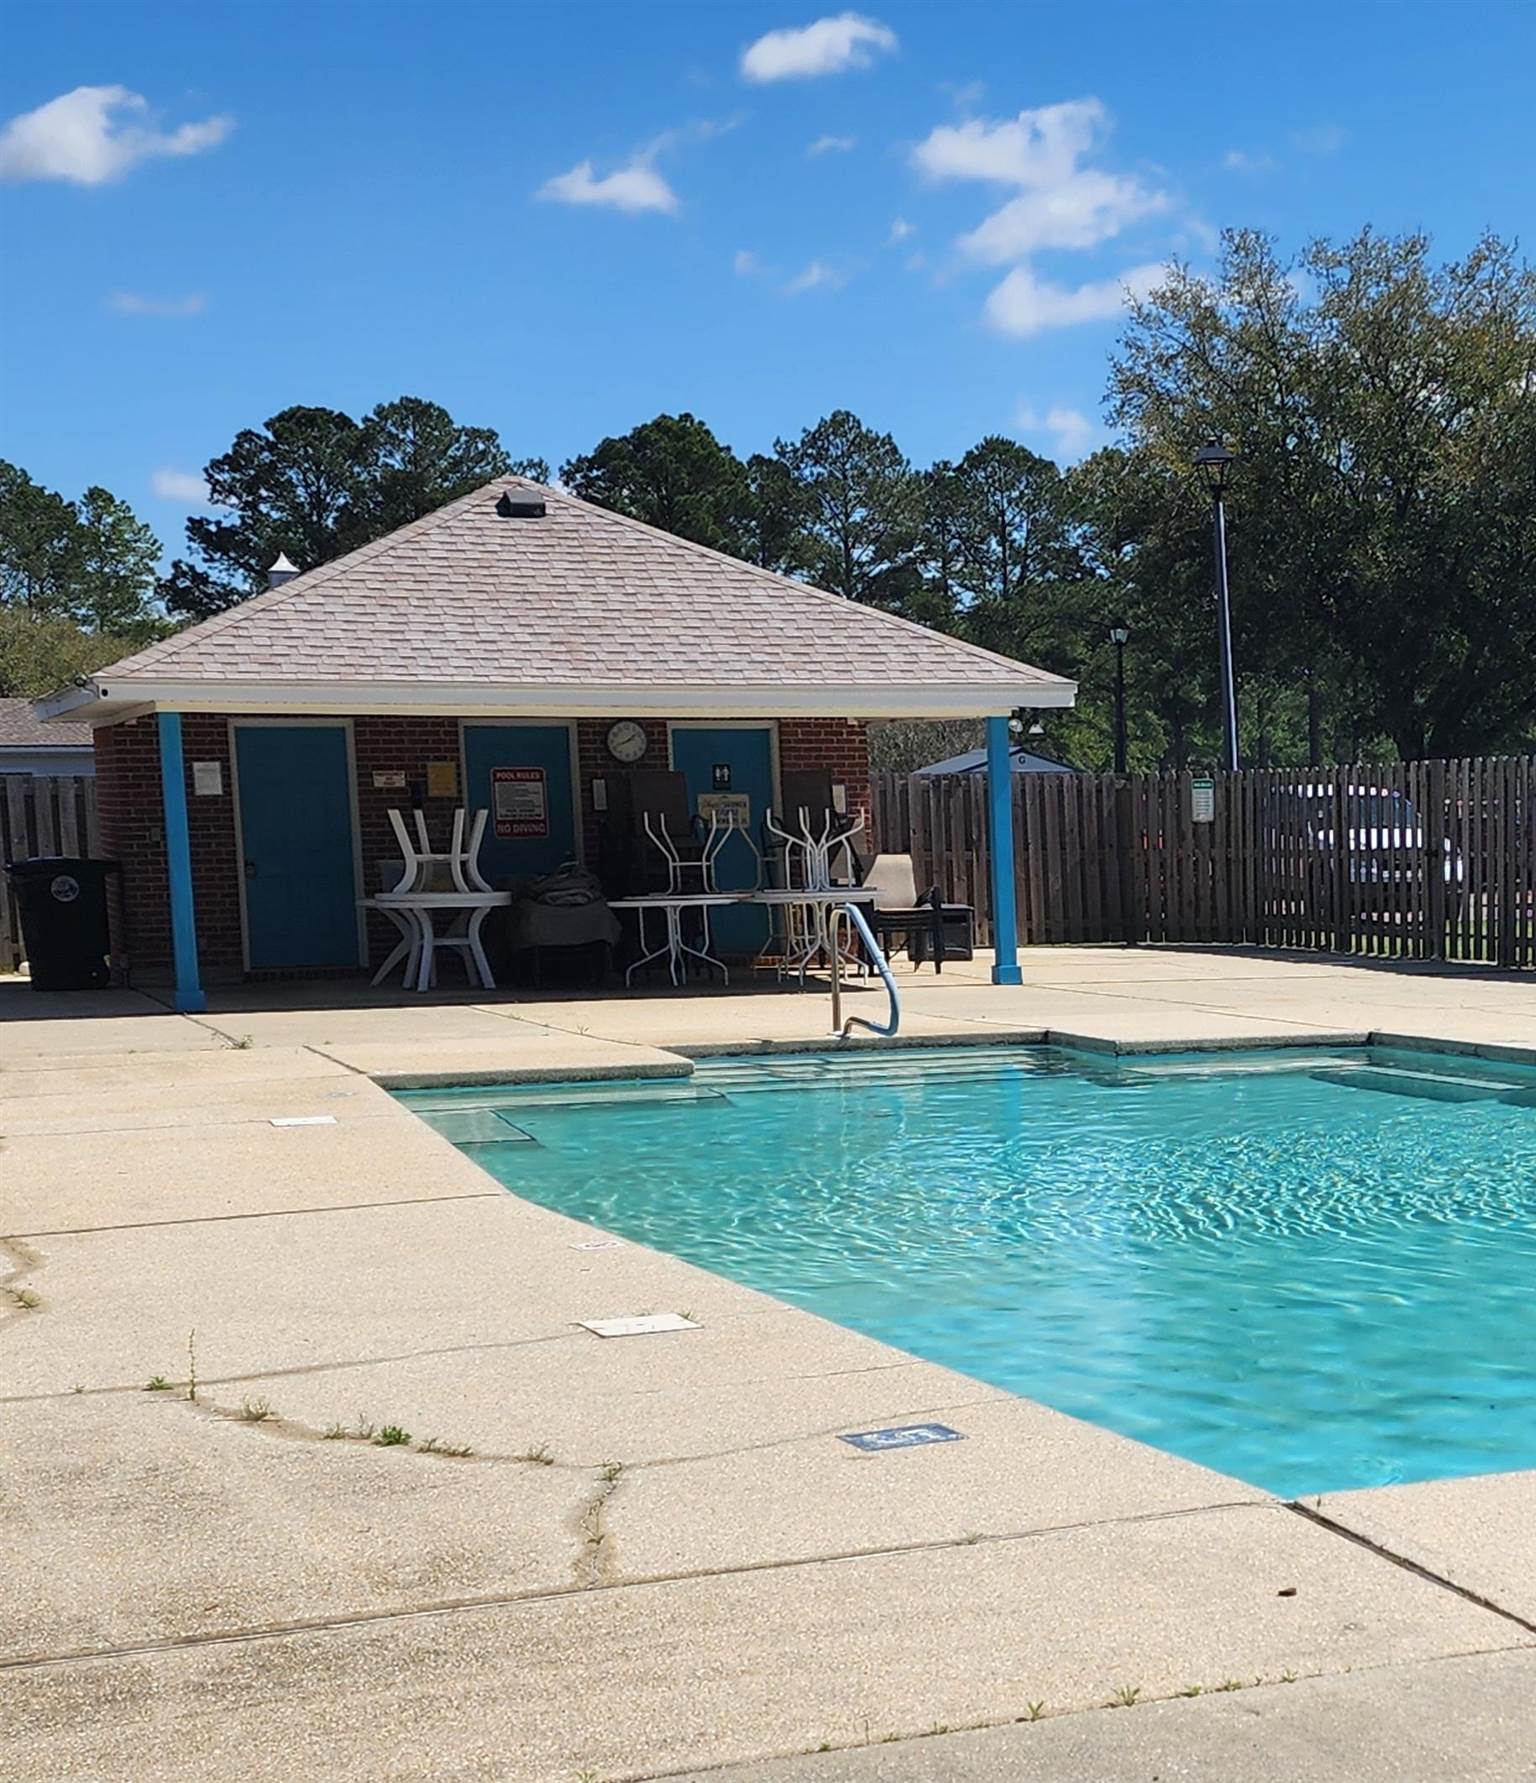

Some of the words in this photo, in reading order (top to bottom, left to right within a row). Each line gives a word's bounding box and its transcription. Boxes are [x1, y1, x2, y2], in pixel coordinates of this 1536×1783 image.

[496, 772, 516, 780] POOL
[517, 772, 541, 780] RULES
[497, 823, 511, 833] NO
[512, 822, 546, 833] DIVING
